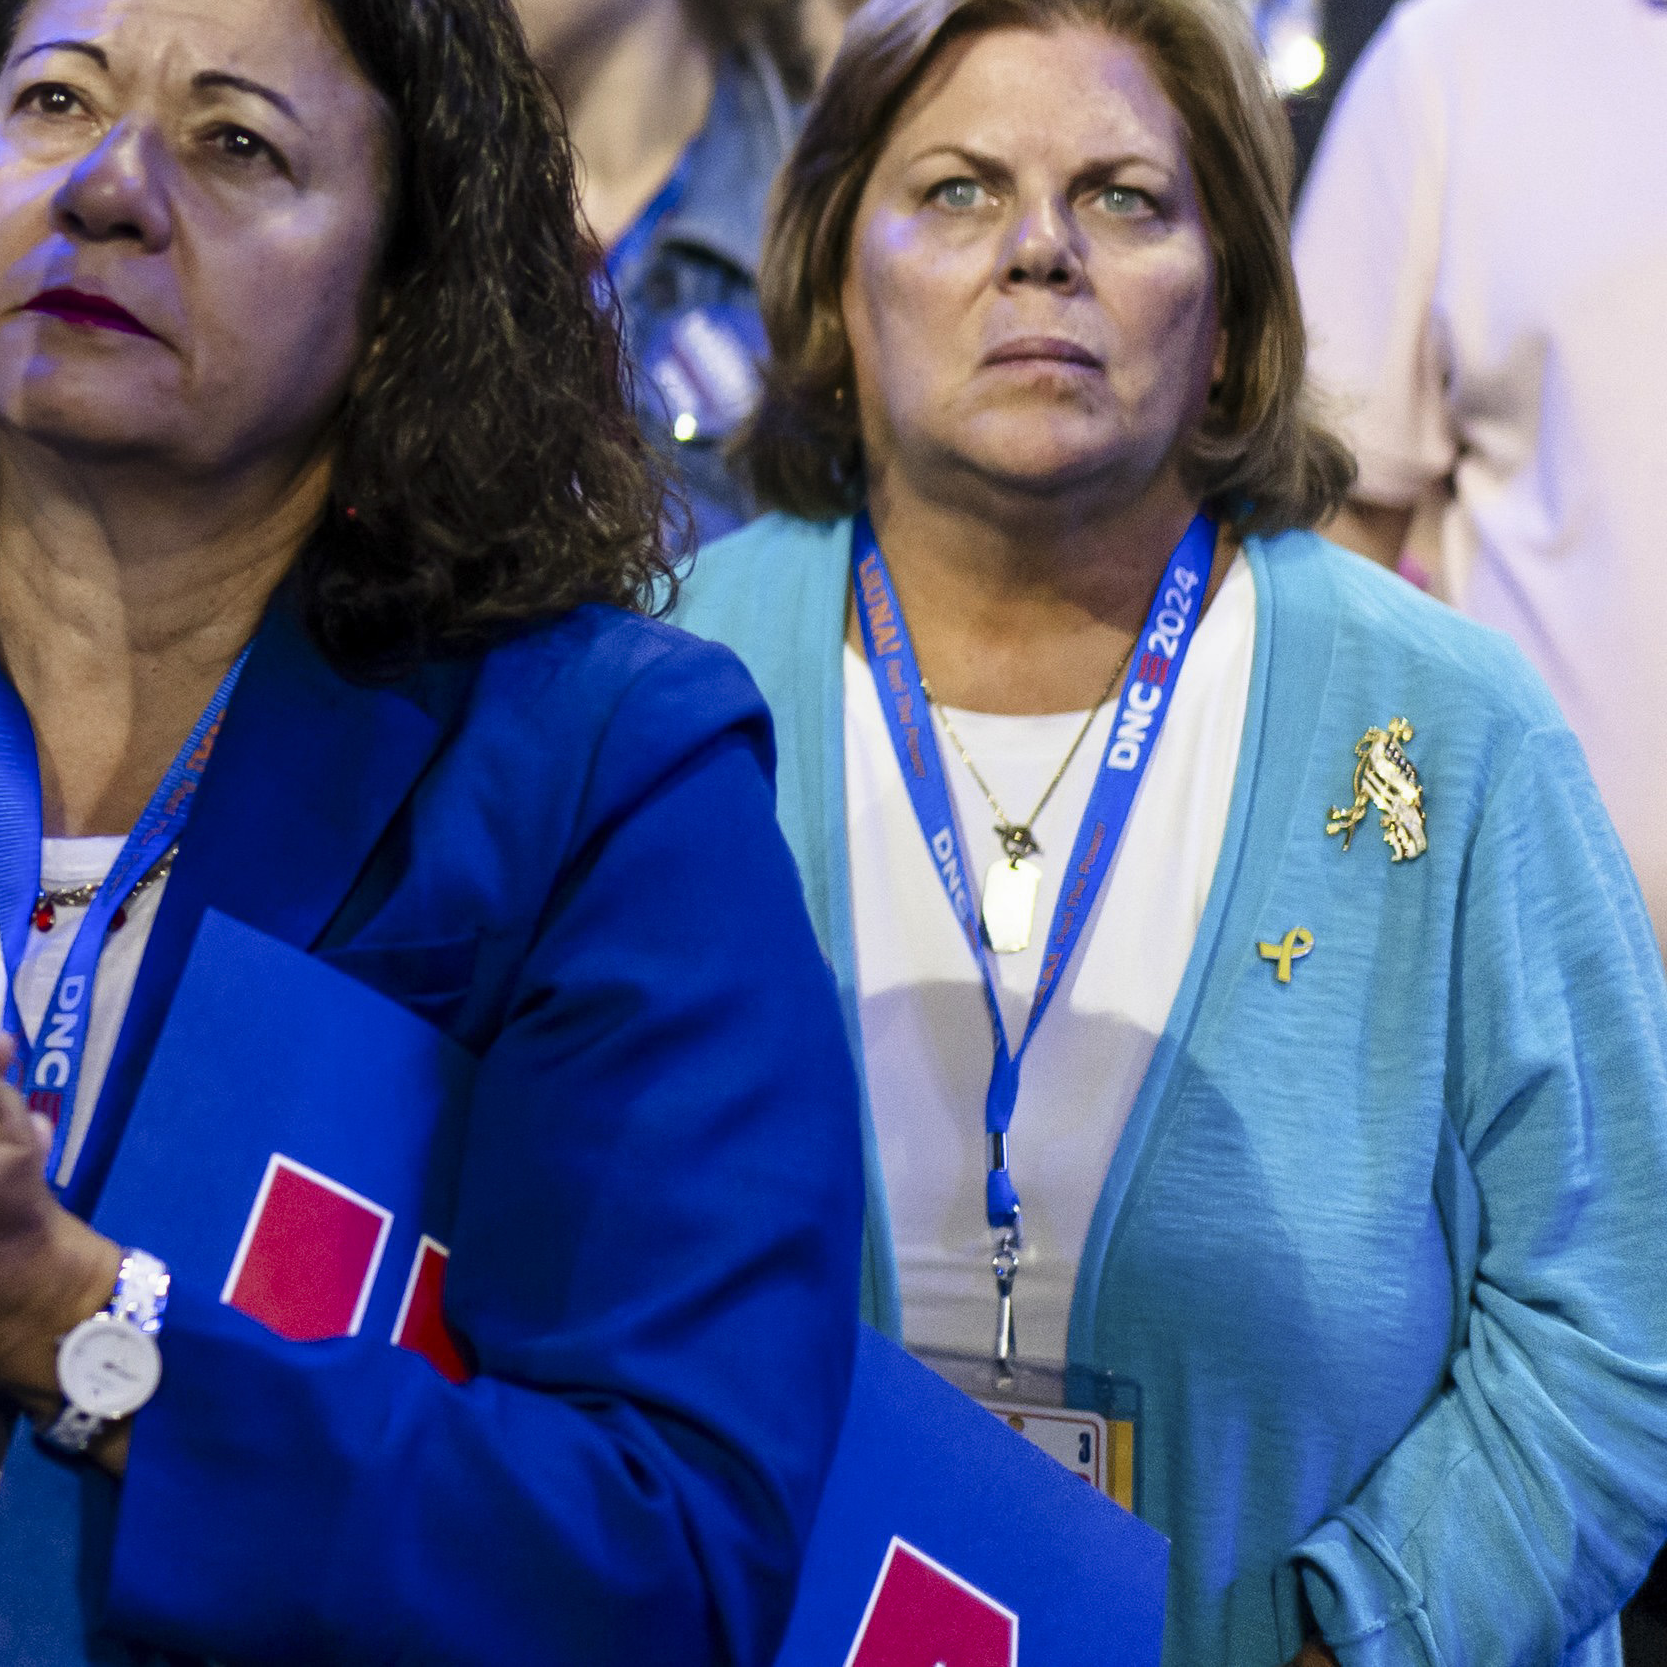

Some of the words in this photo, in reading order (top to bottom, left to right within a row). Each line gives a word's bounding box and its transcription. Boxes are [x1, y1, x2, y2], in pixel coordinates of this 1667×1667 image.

[1106, 681, 1163, 772] DNC
[1148, 565, 1200, 660] 2024
[34, 974, 87, 1088] DNC
